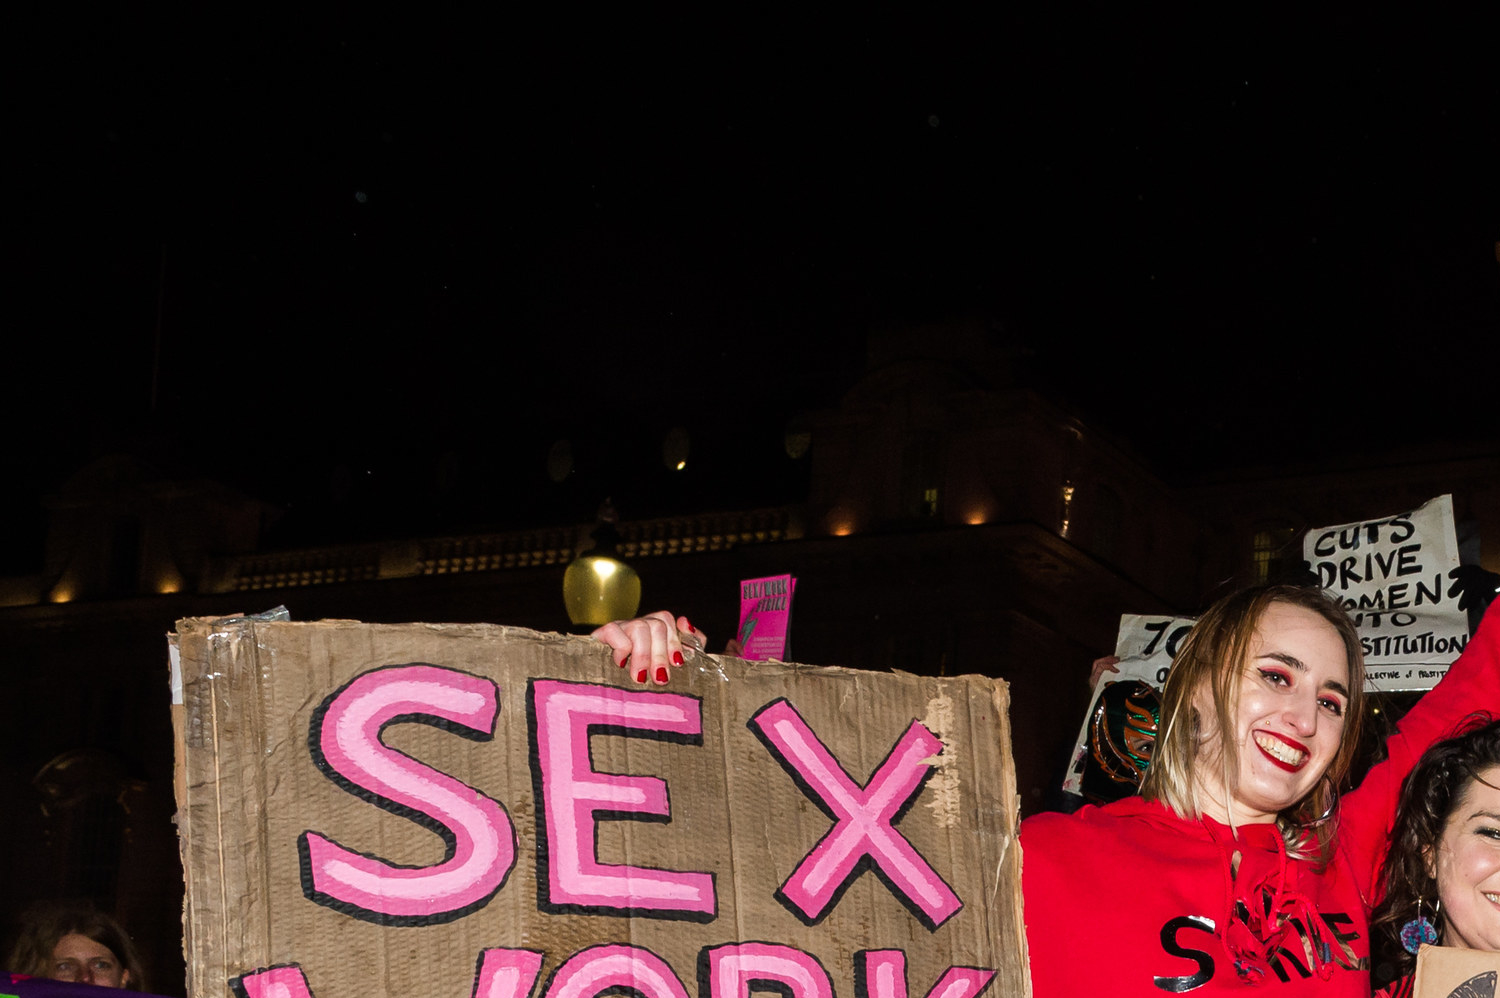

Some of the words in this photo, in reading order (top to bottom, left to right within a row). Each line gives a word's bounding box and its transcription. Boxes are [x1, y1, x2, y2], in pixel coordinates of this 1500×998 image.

[1314, 512, 1416, 557] CUTS
[1316, 543, 1423, 591] DRIVE
[1335, 573, 1442, 612] OMEN
[1360, 631, 1468, 657] STITUTION
[299, 662, 965, 932] SEX
